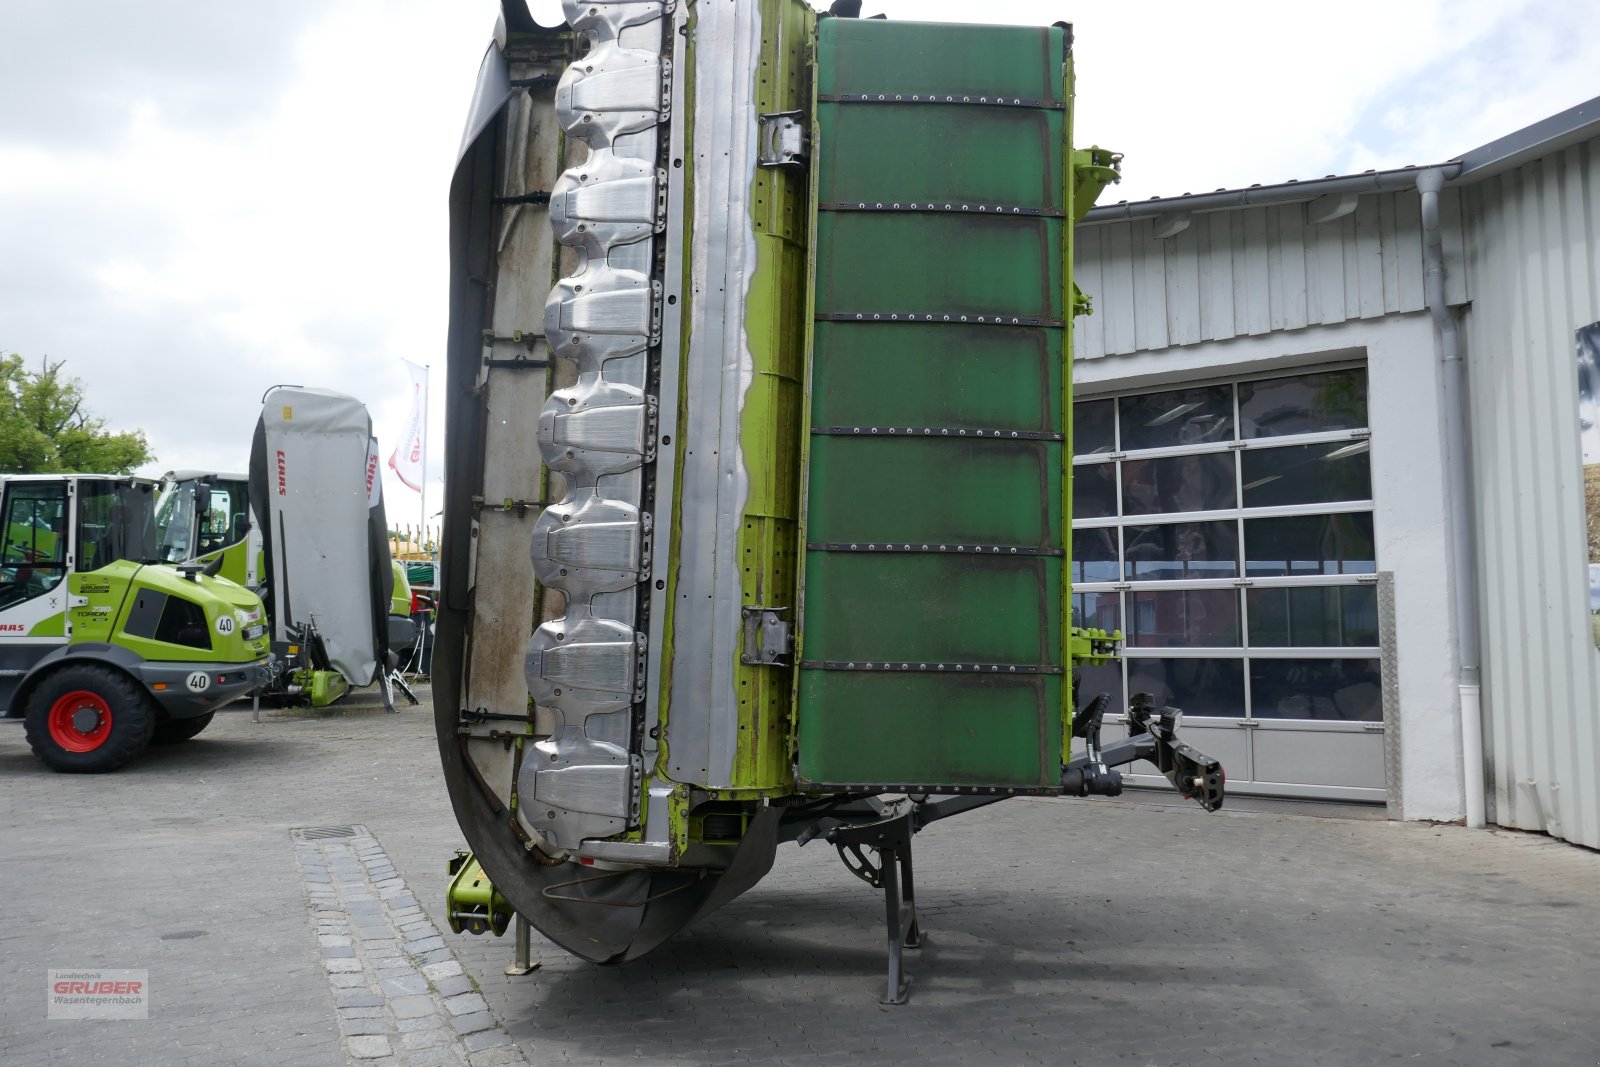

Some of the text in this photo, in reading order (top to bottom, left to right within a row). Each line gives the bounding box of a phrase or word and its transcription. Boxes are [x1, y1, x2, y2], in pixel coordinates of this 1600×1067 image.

[277, 450, 286, 496] CLAAS
[219, 618, 232, 632] 40
[190, 675, 206, 689] 40
